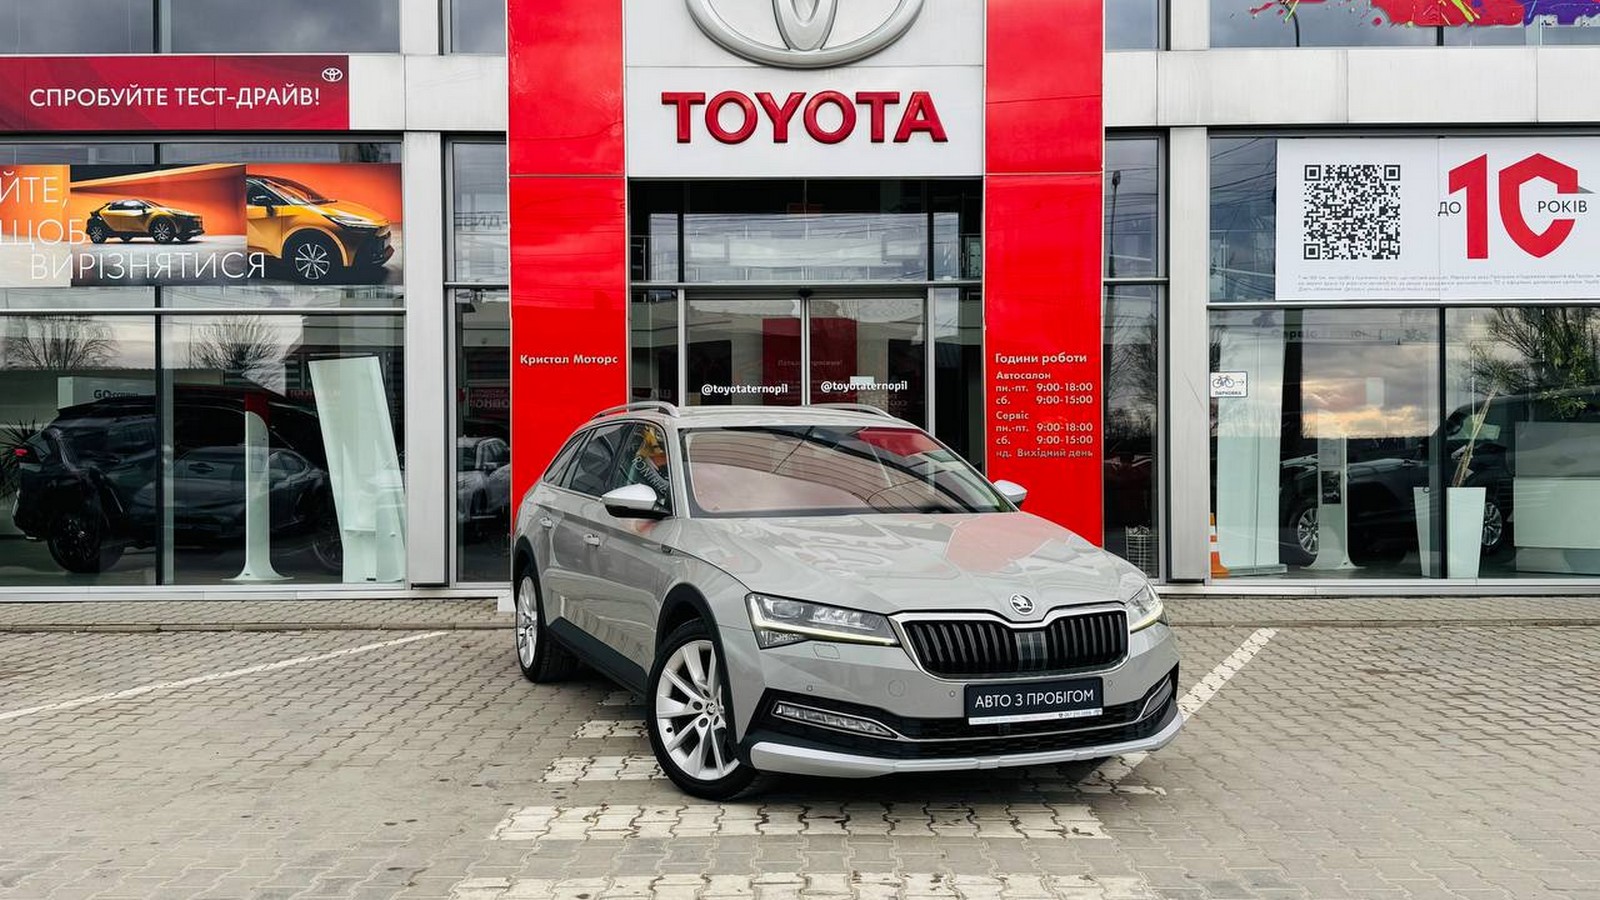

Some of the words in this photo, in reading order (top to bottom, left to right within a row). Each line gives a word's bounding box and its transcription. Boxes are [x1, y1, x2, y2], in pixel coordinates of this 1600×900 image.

[29, 84, 168, 108] СПРОБУЙТЕ
[174, 83, 320, 109] ТЕСТ-ДРАЙВ!
[661, 90, 948, 145] TOYOTA
[1438, 201, 1462, 217] ДО
[1448, 153, 1579, 260] 10
[1537, 200, 1588, 214] РОКІВ
[31, 251, 266, 281] ВИРІЗНЯТИСЯ
[520, 354, 570, 366] Кристал
[573, 354, 619, 366] Моторс
[995, 353, 1038, 364] Години
[1042, 351, 1087, 365] роботи
[996, 370, 1051, 380] Автосалон
[701, 384, 789, 396] @toyotaternopil
[820, 381, 908, 393] @toyotaternopil
[1036, 383, 1093, 391] 9:00-18:00
[995, 396, 1011, 405] сб.
[1036, 396, 1093, 404] 9:00-15:00
[995, 410, 1030, 421] Сервіс
[1036, 423, 1093, 431] 9:00-18:00
[995, 436, 1011, 445] сб.
[1036, 436, 1093, 444] 9:00-15:00
[995, 450, 1012, 459] нд.
[1016, 448, 1067, 458] Вихідний
[1068, 449, 1094, 459] день
[975, 693, 1012, 708] АВТО
[1026, 689, 1095, 706] ПРОБІГОМ
